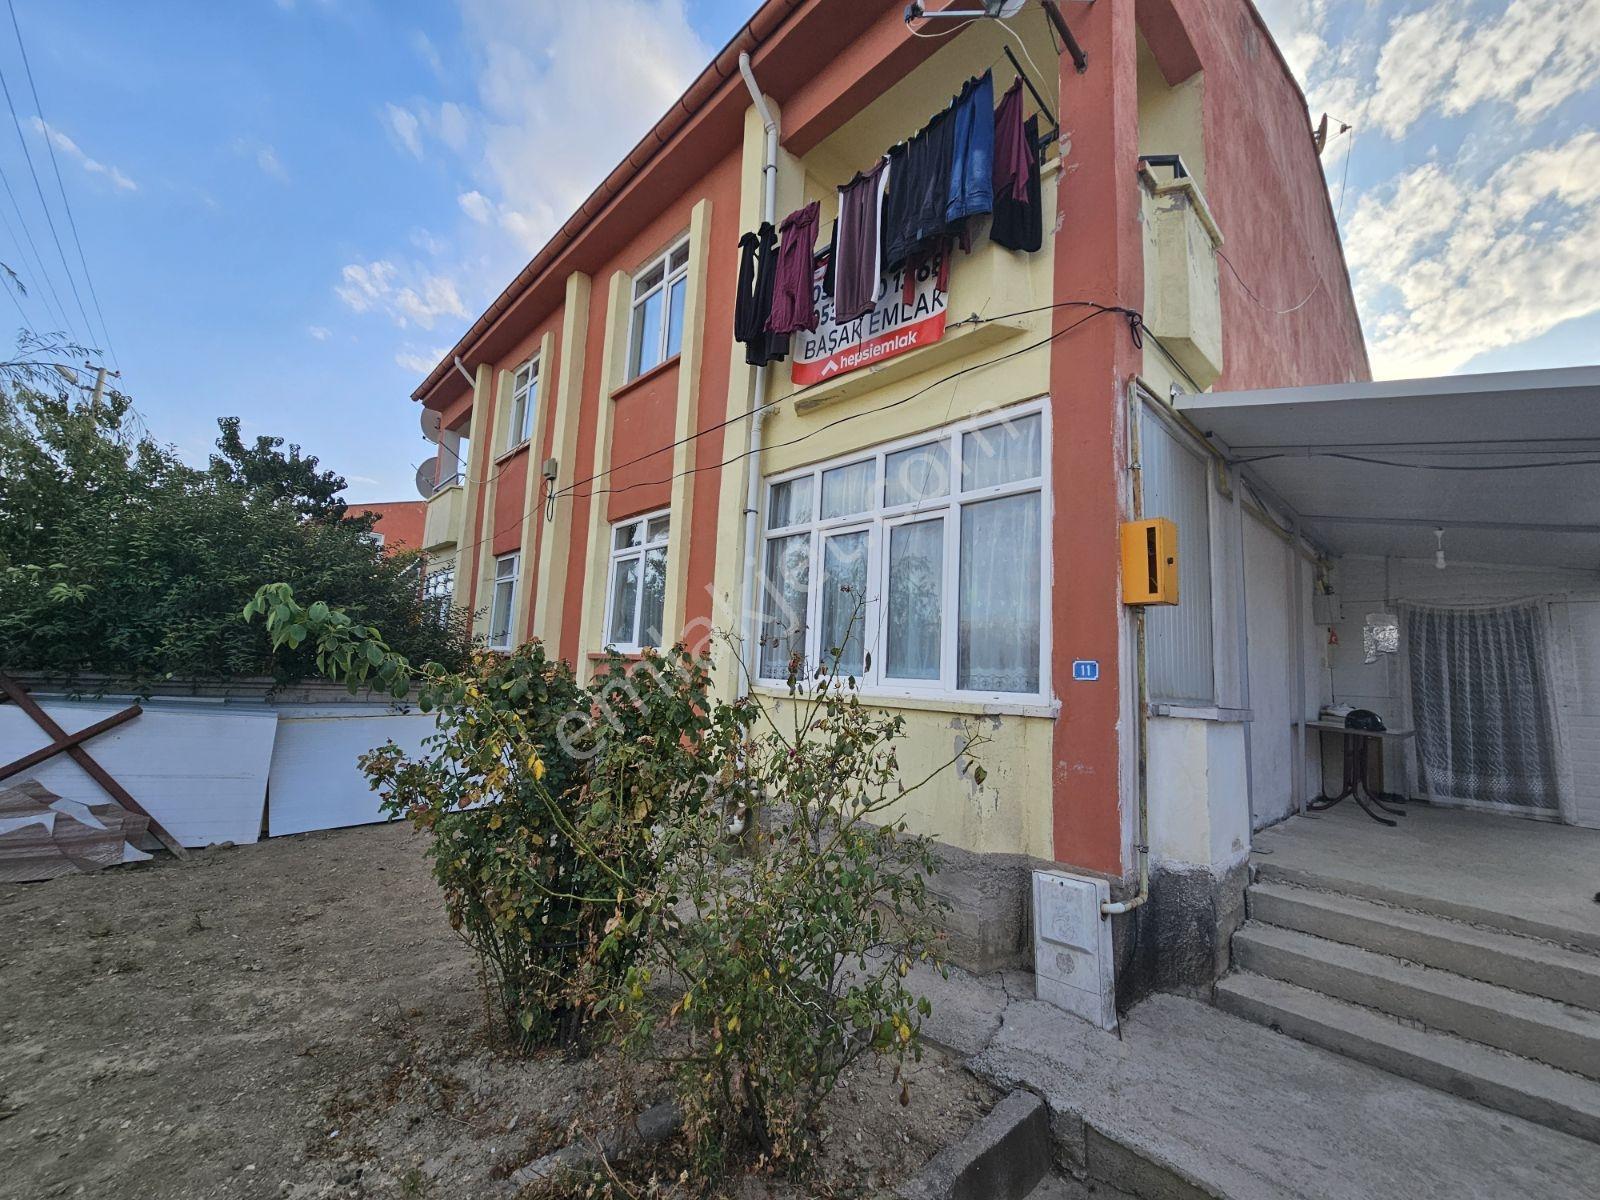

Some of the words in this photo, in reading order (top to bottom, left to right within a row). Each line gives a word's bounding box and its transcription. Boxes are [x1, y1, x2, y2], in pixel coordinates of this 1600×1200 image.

[804, 323, 862, 360] BAŞAK
[869, 288, 943, 335] EMLAK
[840, 331, 917, 368] hepsiemlak
[1081, 665, 1090, 676] 11
